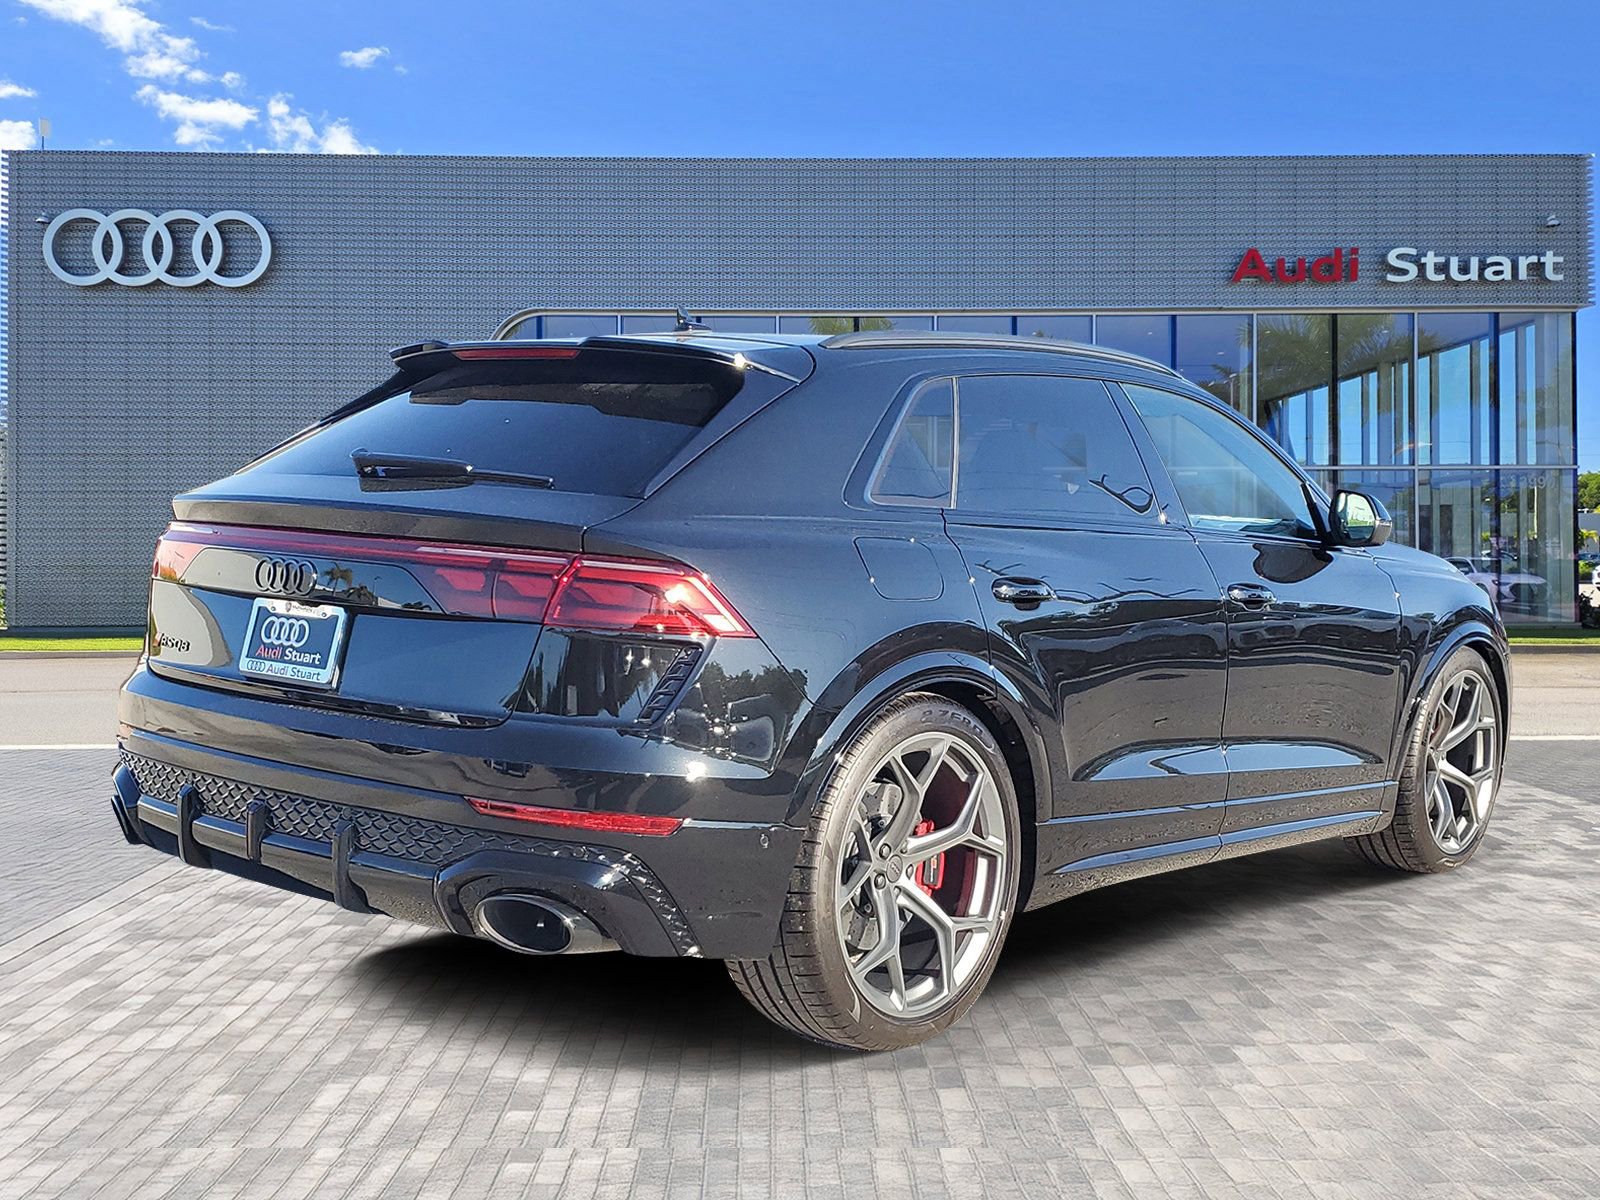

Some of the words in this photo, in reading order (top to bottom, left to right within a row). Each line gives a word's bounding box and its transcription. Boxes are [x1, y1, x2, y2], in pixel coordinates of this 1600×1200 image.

[1231, 247, 1359, 283] Audi
[1386, 247, 1565, 282] Stuart
[255, 645, 283, 659] Audi
[284, 648, 321, 664] Stuart
[266, 664, 289, 676] Audi
[290, 667, 322, 681] Stuart
